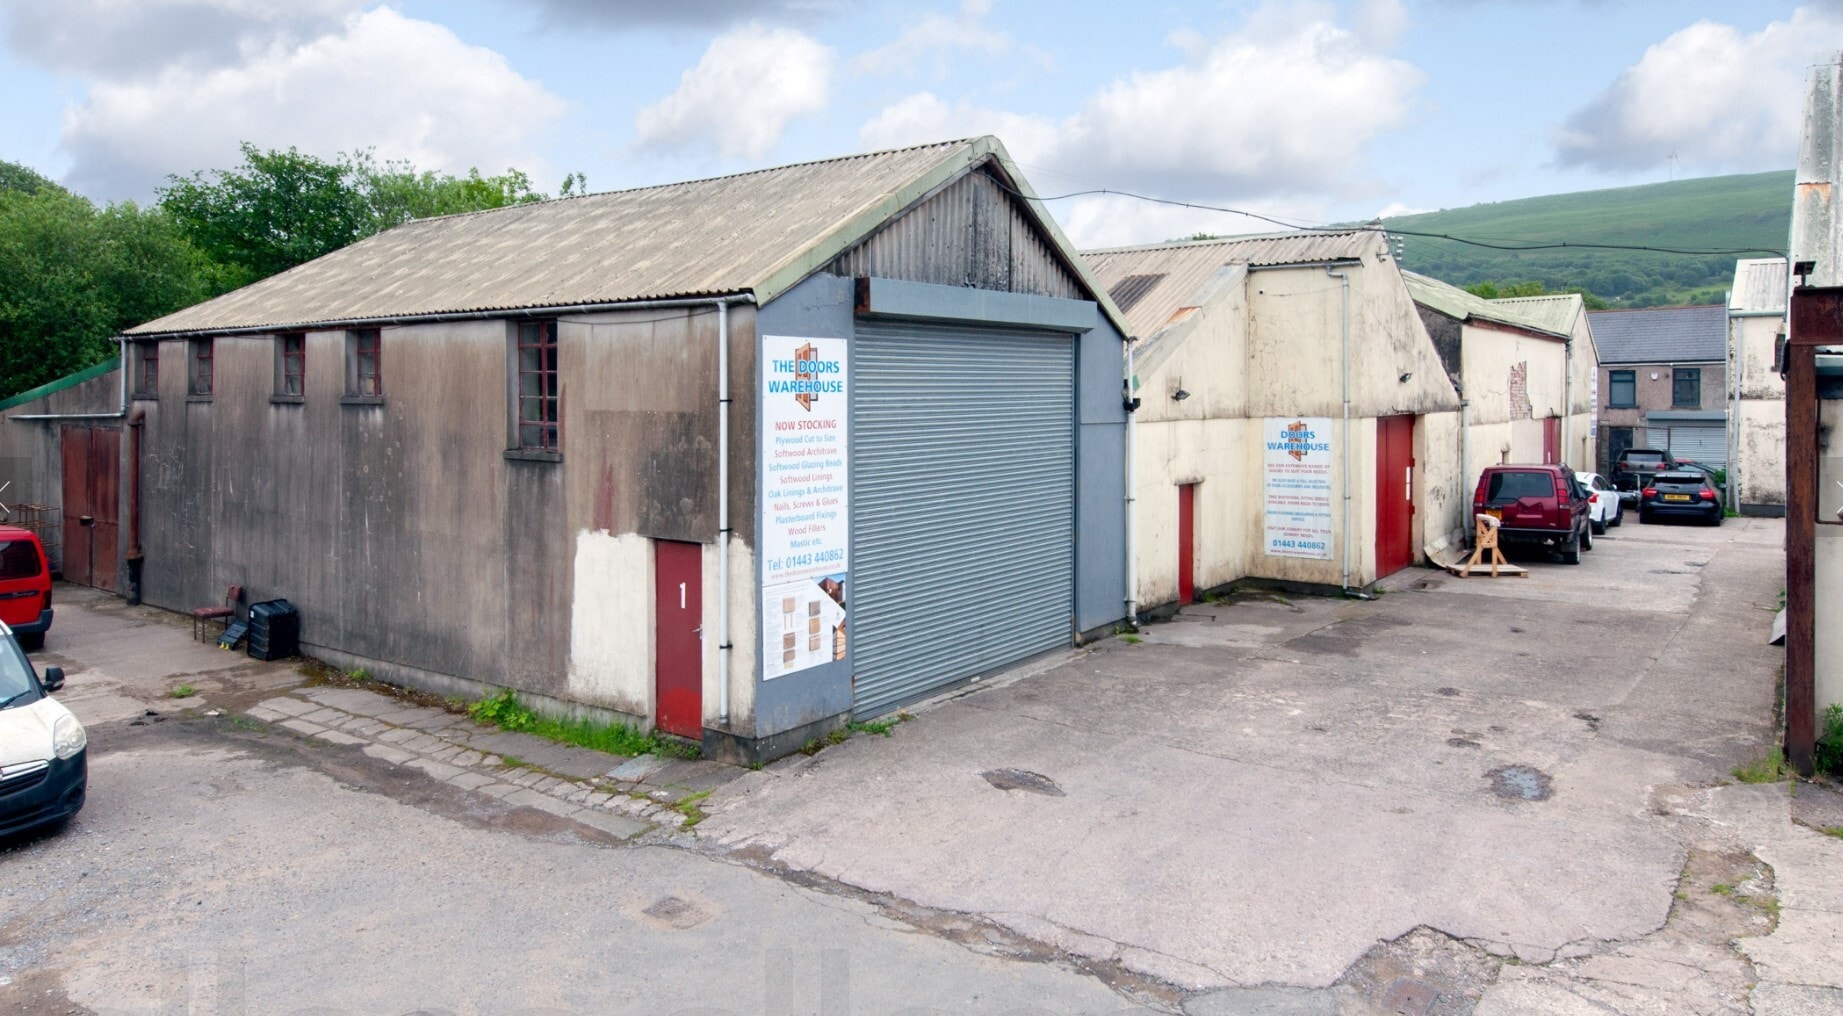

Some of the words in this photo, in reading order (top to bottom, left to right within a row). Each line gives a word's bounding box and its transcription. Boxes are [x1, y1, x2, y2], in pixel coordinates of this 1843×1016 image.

[772, 360, 794, 373] THE
[798, 360, 840, 373] DOORS
[768, 380, 843, 394] WAREHOUSE
[775, 421, 795, 431] NOW
[798, 419, 836, 430] STOCKING
[776, 435, 802, 446] Plywood
[804, 435, 814, 443] Cut
[824, 434, 836, 442] Size
[1280, 430, 1315, 439] DOORS
[774, 448, 805, 458] Softwood
[807, 447, 837, 456] Architrave
[1267, 442, 1330, 451] WAREHOUSE
[769, 461, 800, 472] Softwood
[802, 460, 824, 470] Glazing
[826, 459, 842, 467] Beads
[780, 474, 811, 484] Softwood
[812, 473, 833, 483] Linings
[768, 489, 781, 498] Oak
[783, 487, 805, 498] Linings
[807, 486, 811, 494] &
[813, 484, 843, 494] Architrave
[774, 501, 791, 511] Nails,
[793, 499, 813, 509] Screws
[821, 497, 838, 506] Glues
[776, 513, 815, 524] Plasterboard
[816, 511, 837, 522] Fixings
[788, 526, 807, 536] Wood
[809, 524, 826, 533] Fillers
[790, 540, 810, 548] Mastic
[1273, 539, 1295, 548] 01443
[1298, 541, 1325, 549] 440862
[768, 559, 783, 571] Tel:
[786, 554, 812, 568] 01443
[814, 548, 844, 564] 440862
[680, 582, 686, 609] 1
